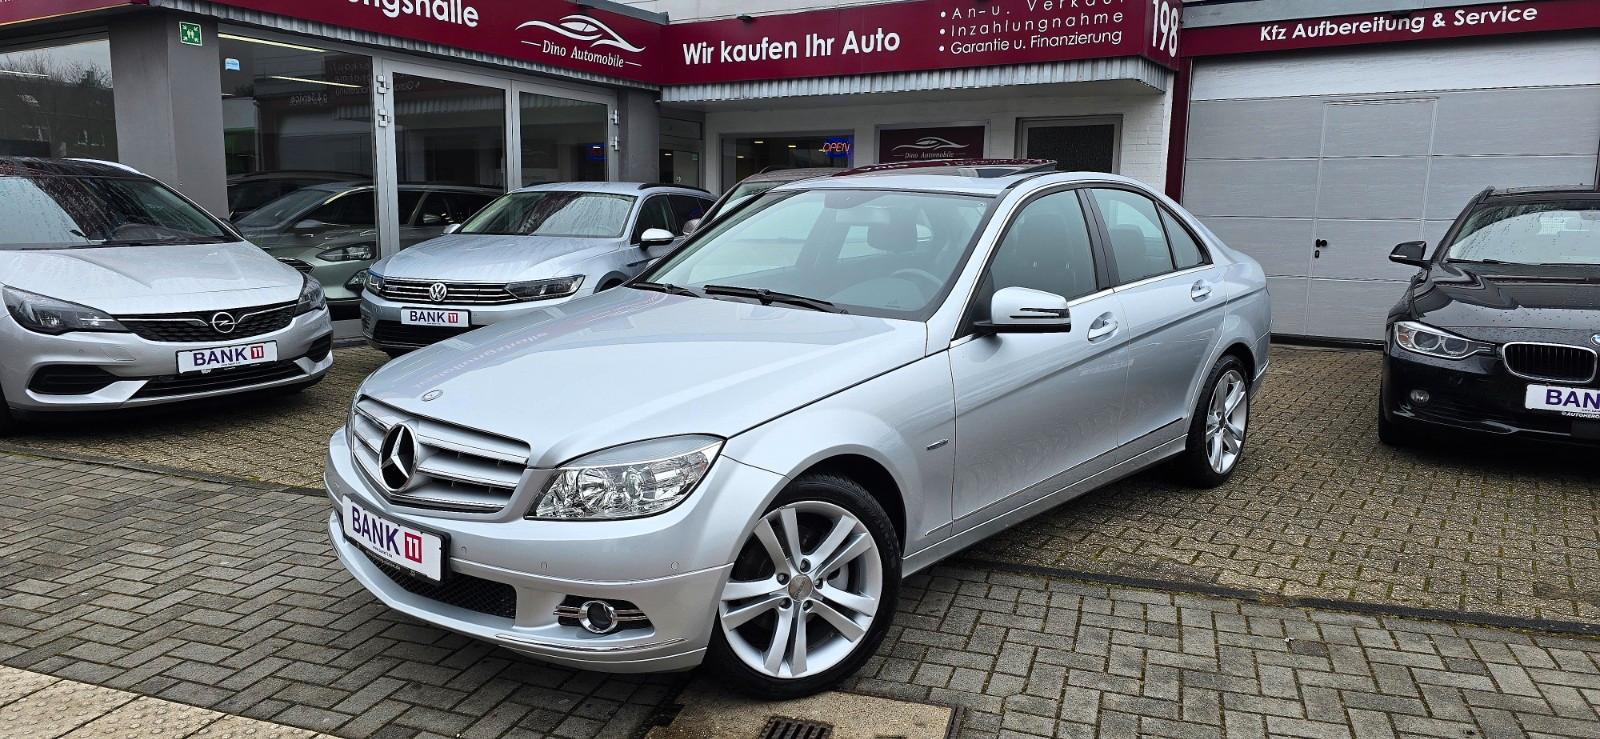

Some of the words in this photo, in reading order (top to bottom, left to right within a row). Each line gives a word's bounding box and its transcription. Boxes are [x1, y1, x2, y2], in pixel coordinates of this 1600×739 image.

[347, 0, 479, 27] gshalle
[1027, 0, 1123, 12] Verka
[951, 11, 1123, 37] Inzahlungnahme
[1152, 0, 1178, 57] 198
[1260, 25, 1287, 42] Kfz
[1292, 15, 1425, 38] Aufbereitung
[1432, 12, 1446, 27] &
[1453, 5, 1538, 26] Service
[542, 39, 566, 57] Dino
[570, 46, 624, 68] Automobile
[682, 41, 714, 65] Wir
[720, 37, 798, 63] kaufen
[805, 33, 835, 57] Ihr
[841, 27, 900, 55] Auto
[951, 37, 1009, 54] Garantie
[1013, 38, 1026, 49] u.
[1030, 30, 1122, 49] Finanzierung
[823, 141, 849, 153] OPEN
[410, 311, 445, 323] BANK
[448, 313, 458, 323] 11
[193, 347, 247, 366] BANK
[251, 346, 264, 359] 11
[1545, 389, 1600, 409] BAN
[352, 505, 400, 556] BANK
[405, 532, 422, 563] 11
